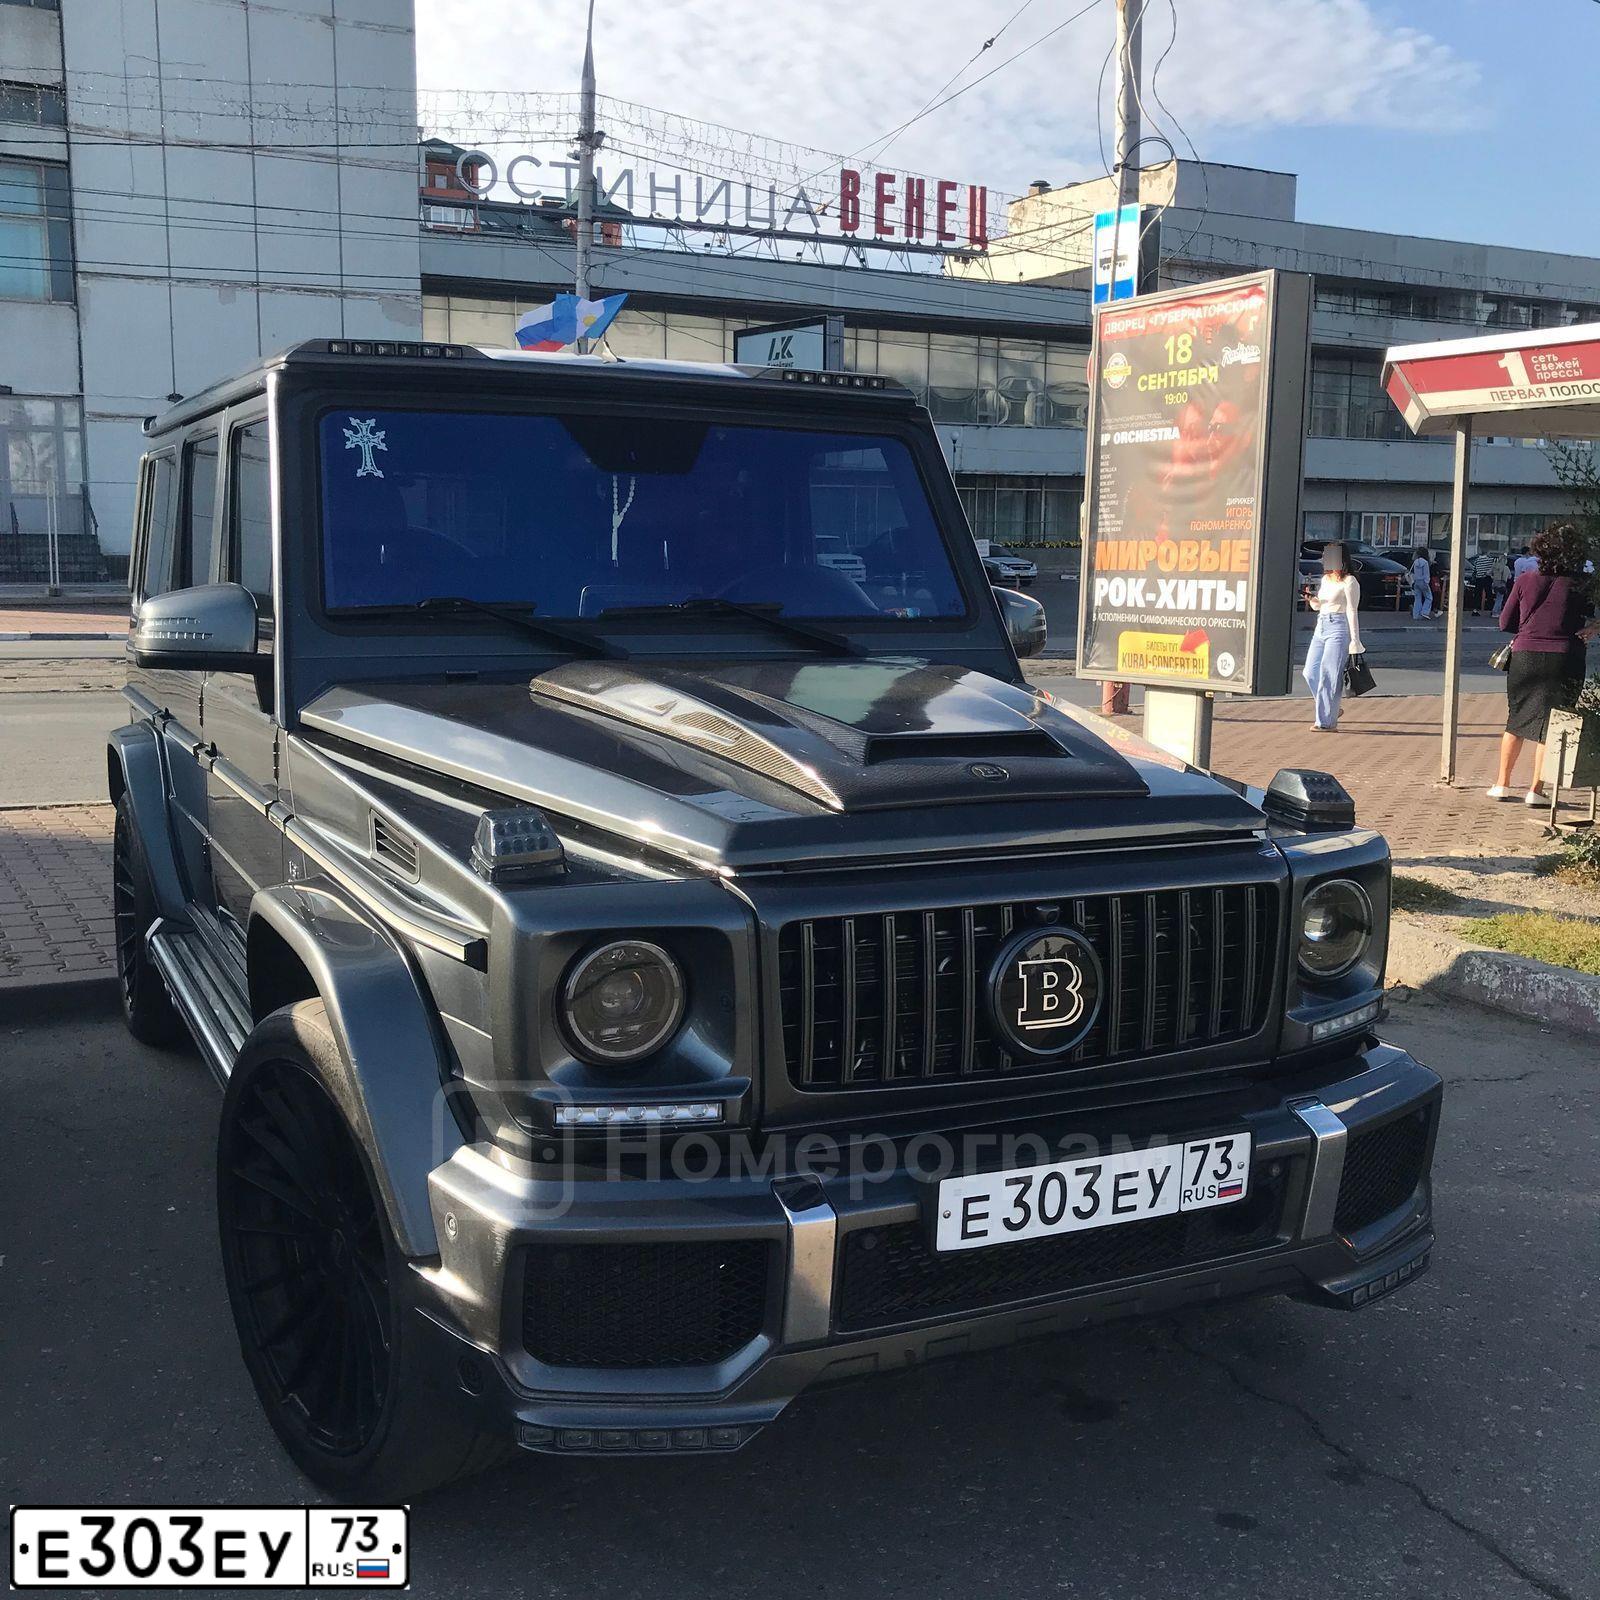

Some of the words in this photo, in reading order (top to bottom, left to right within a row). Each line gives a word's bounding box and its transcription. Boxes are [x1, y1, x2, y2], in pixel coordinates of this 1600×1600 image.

[840, 168, 988, 251] ВЕНЕЦ
[1104, 317, 1146, 336] ДВОРЕЦ
[1164, 333, 1193, 365] 18
[1531, 353, 1559, 364] сеть
[1497, 351, 1531, 386] 1
[1533, 357, 1580, 372] свежей
[1137, 366, 1219, 392] СЕНТЯБРЯ
[1536, 369, 1583, 381] прессы
[1165, 391, 1188, 405] 19:00
[1490, 387, 1547, 402] ПЕРВАЯ
[1113, 426, 1180, 445] ORCHESTRA
[1226, 507, 1253, 517] ИГОРЬ
[1190, 519, 1252, 531] ПОНОМАРЕНКО
[1096, 539, 1250, 573] МИРОВЫЕ
[1094, 577, 1248, 612] РОК-ХИТЫ
[1140, 614, 1207, 627] СИМФОНИЧЕСКОГО
[1208, 617, 1247, 629] ОРКЕСТРА
[1017, 957, 1084, 1030] B
[1189, 1139, 1234, 1186] 73
[1182, 1184, 1217, 1204] RUS
